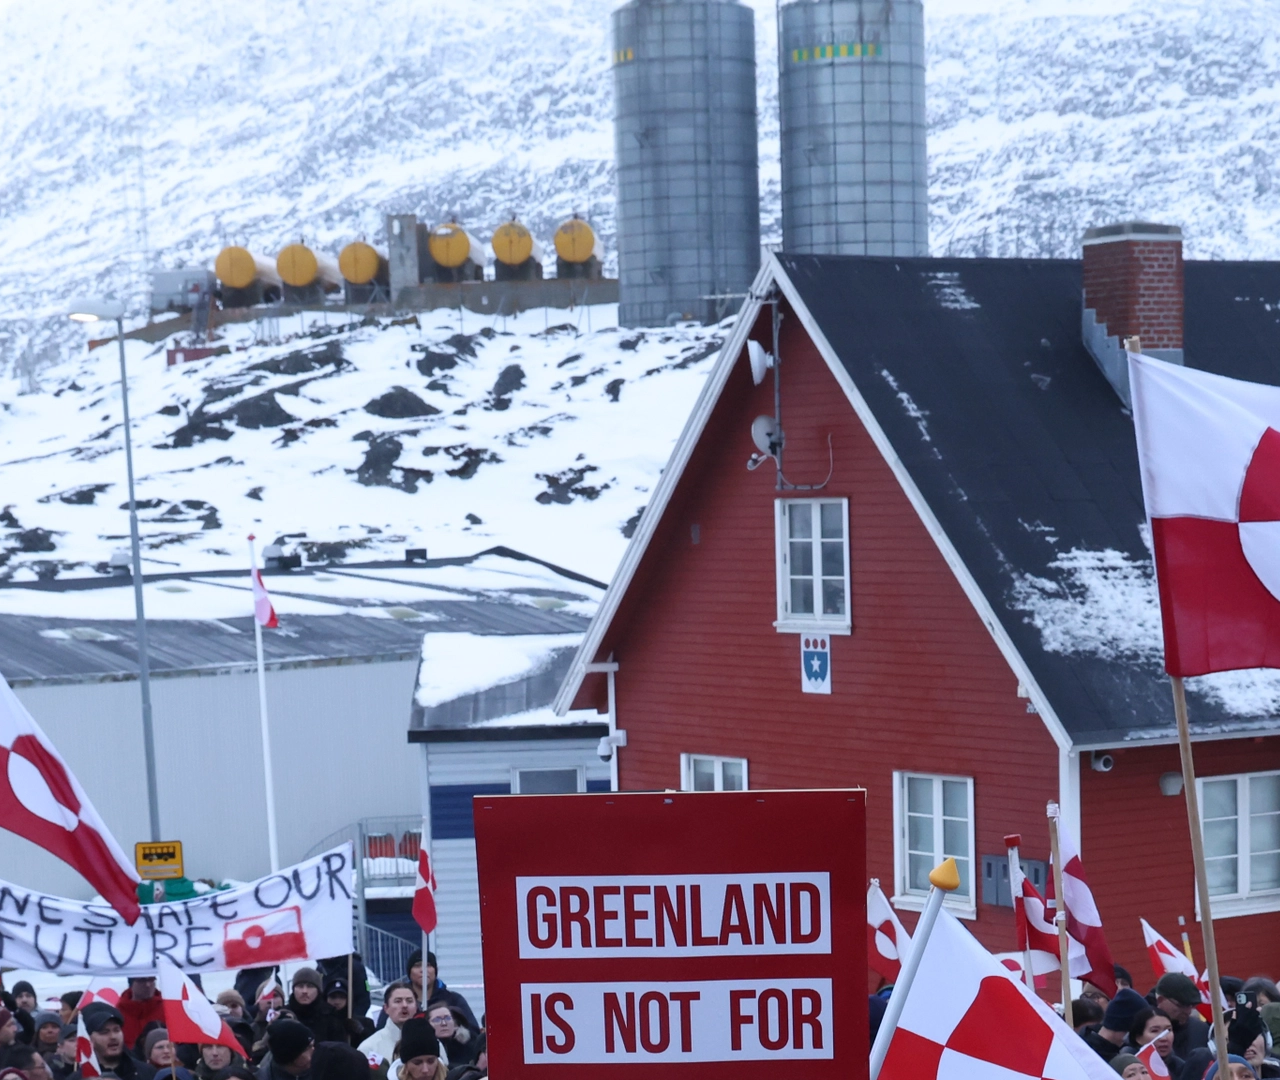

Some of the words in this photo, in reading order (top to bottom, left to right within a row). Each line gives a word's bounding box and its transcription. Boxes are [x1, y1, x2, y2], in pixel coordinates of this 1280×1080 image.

[254, 852, 352, 909] OUR
[527, 882, 822, 949] GREENLAND
[531, 992, 575, 1055] IS
[604, 991, 700, 1054] NOT
[730, 988, 823, 1051] FOR
